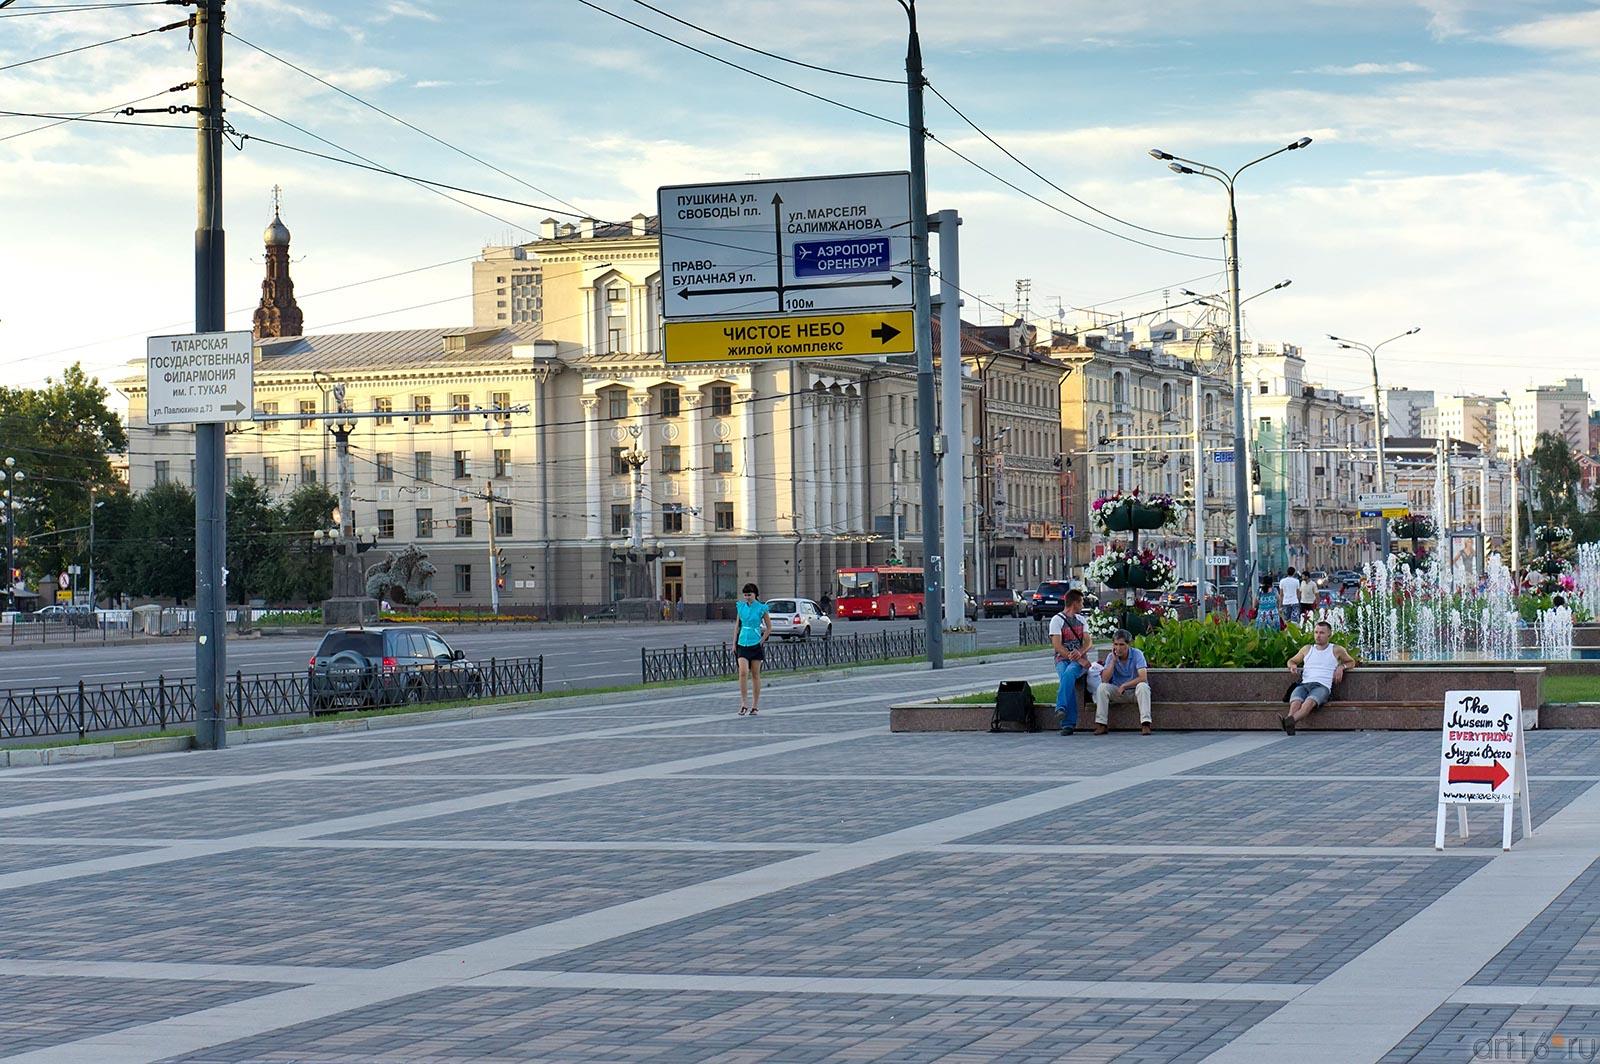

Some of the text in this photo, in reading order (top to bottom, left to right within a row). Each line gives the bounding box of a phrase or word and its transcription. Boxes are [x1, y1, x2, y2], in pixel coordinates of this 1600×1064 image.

[677, 193, 758, 206] ПУШКИНА ул.
[678, 206, 761, 220] СВОБОДЫ пл.
[787, 218, 883, 234] САЛИМЖАНОВА
[817, 242, 884, 257] АЭРОПОРТ
[672, 259, 716, 272] ПРАВО-
[817, 256, 883, 271] ОРЕНБУРГ
[673, 272, 756, 286] БУЛАЧНАЯ ул.
[723, 321, 845, 340] ЧИСТОЕ НЕБО
[171, 338, 228, 352] ТАТАРСКАЯ
[727, 341, 844, 356] жилой комплекс
[150, 352, 250, 370] ГОСУДАРСТВЕННАЯ
[163, 368, 236, 383] ФИЛАРМОНИЯ
[172, 388, 187, 397] им.
[153, 408, 163, 416] ул.
[164, 406, 199, 415] Павлюхина
[1458, 696, 1489, 714] The
[1447, 710, 1513, 732] Museum of
[1449, 731, 1513, 743] EVERYTHING
[1444, 743, 1512, 765] Музей Всего
